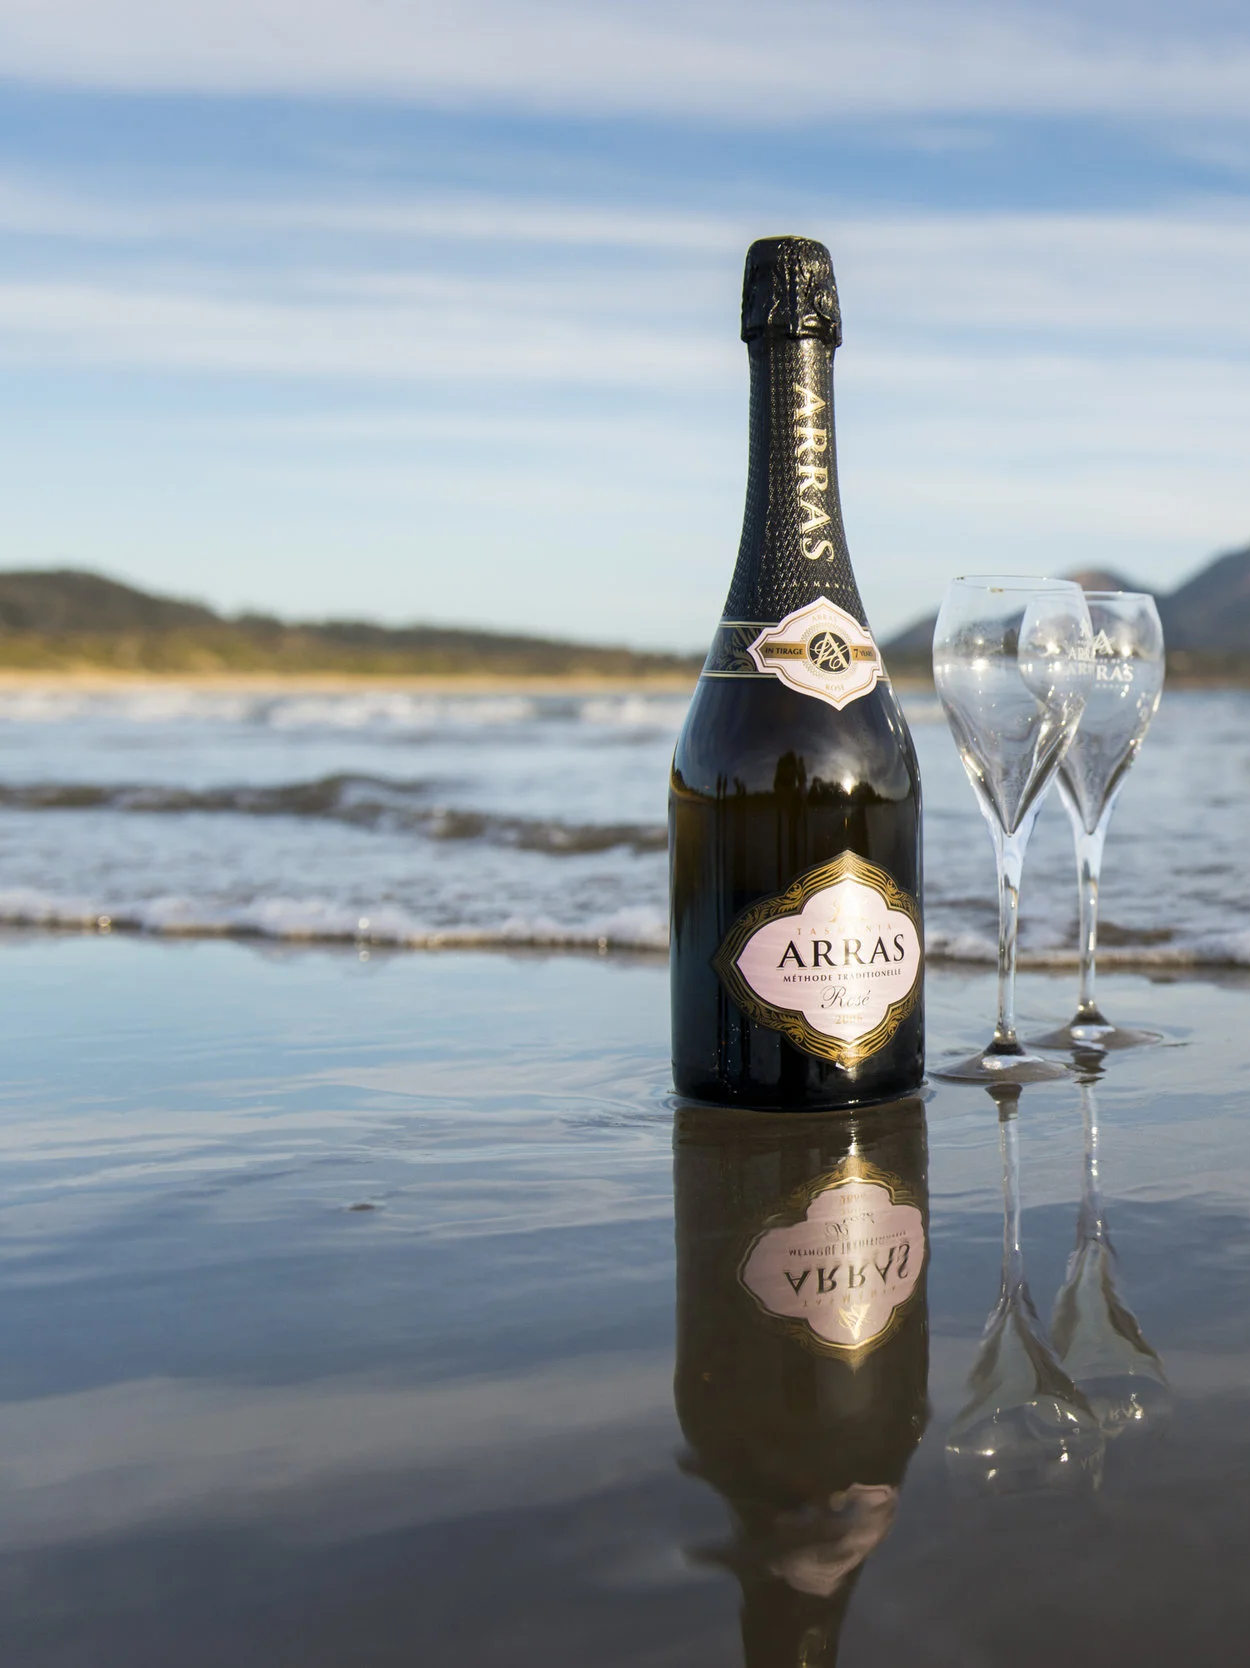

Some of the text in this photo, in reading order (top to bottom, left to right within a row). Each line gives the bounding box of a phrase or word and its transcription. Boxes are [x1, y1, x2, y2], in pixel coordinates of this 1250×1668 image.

[794, 383, 834, 562] ARRAS
[765, 647, 774, 655] IN
[776, 647, 803, 656] TIRAGE
[853, 648, 859, 658] 7
[796, 923, 894, 936] TASMNIA
[777, 933, 905, 969] ARRAS
[783, 974, 834, 983] MÉTHODE
[820, 985, 872, 1010] Rosé
